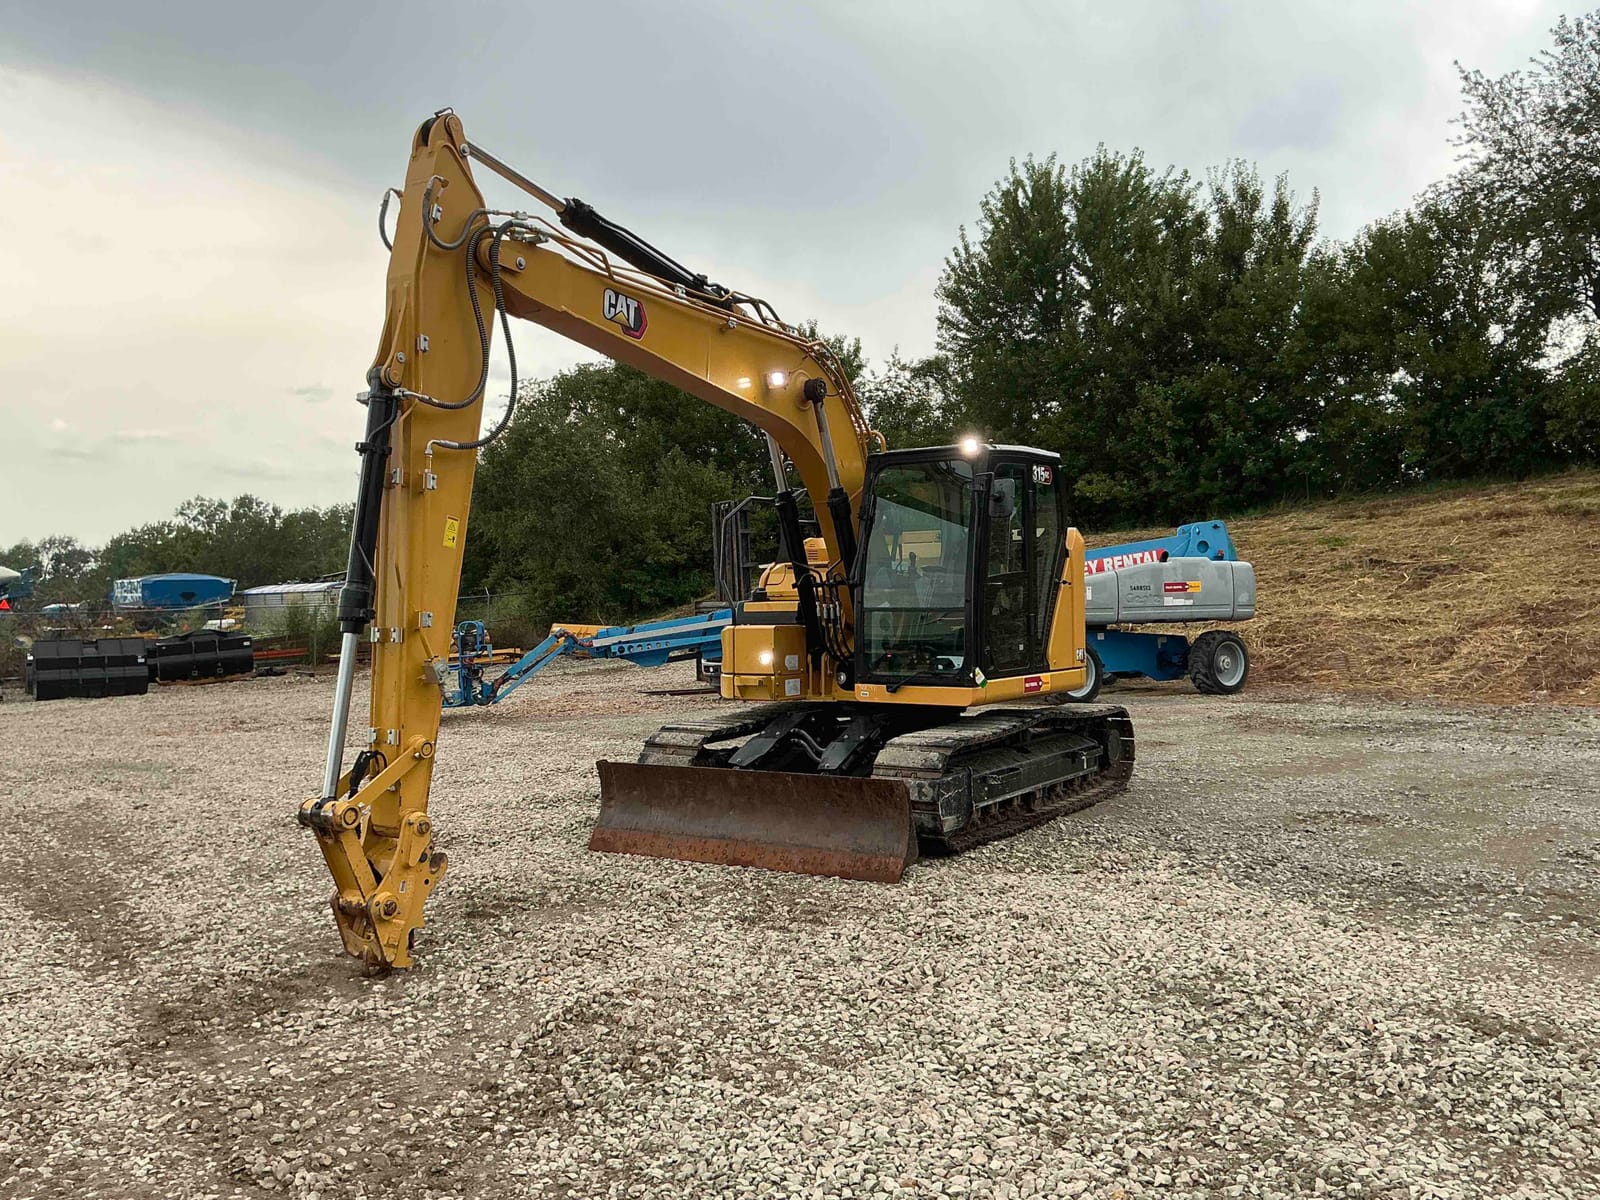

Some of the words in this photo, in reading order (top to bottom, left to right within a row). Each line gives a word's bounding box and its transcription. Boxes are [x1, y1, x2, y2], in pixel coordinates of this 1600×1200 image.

[604, 289, 638, 328] CAT
[1032, 465, 1045, 482] 315
[1103, 550, 1158, 572] RENTAL
